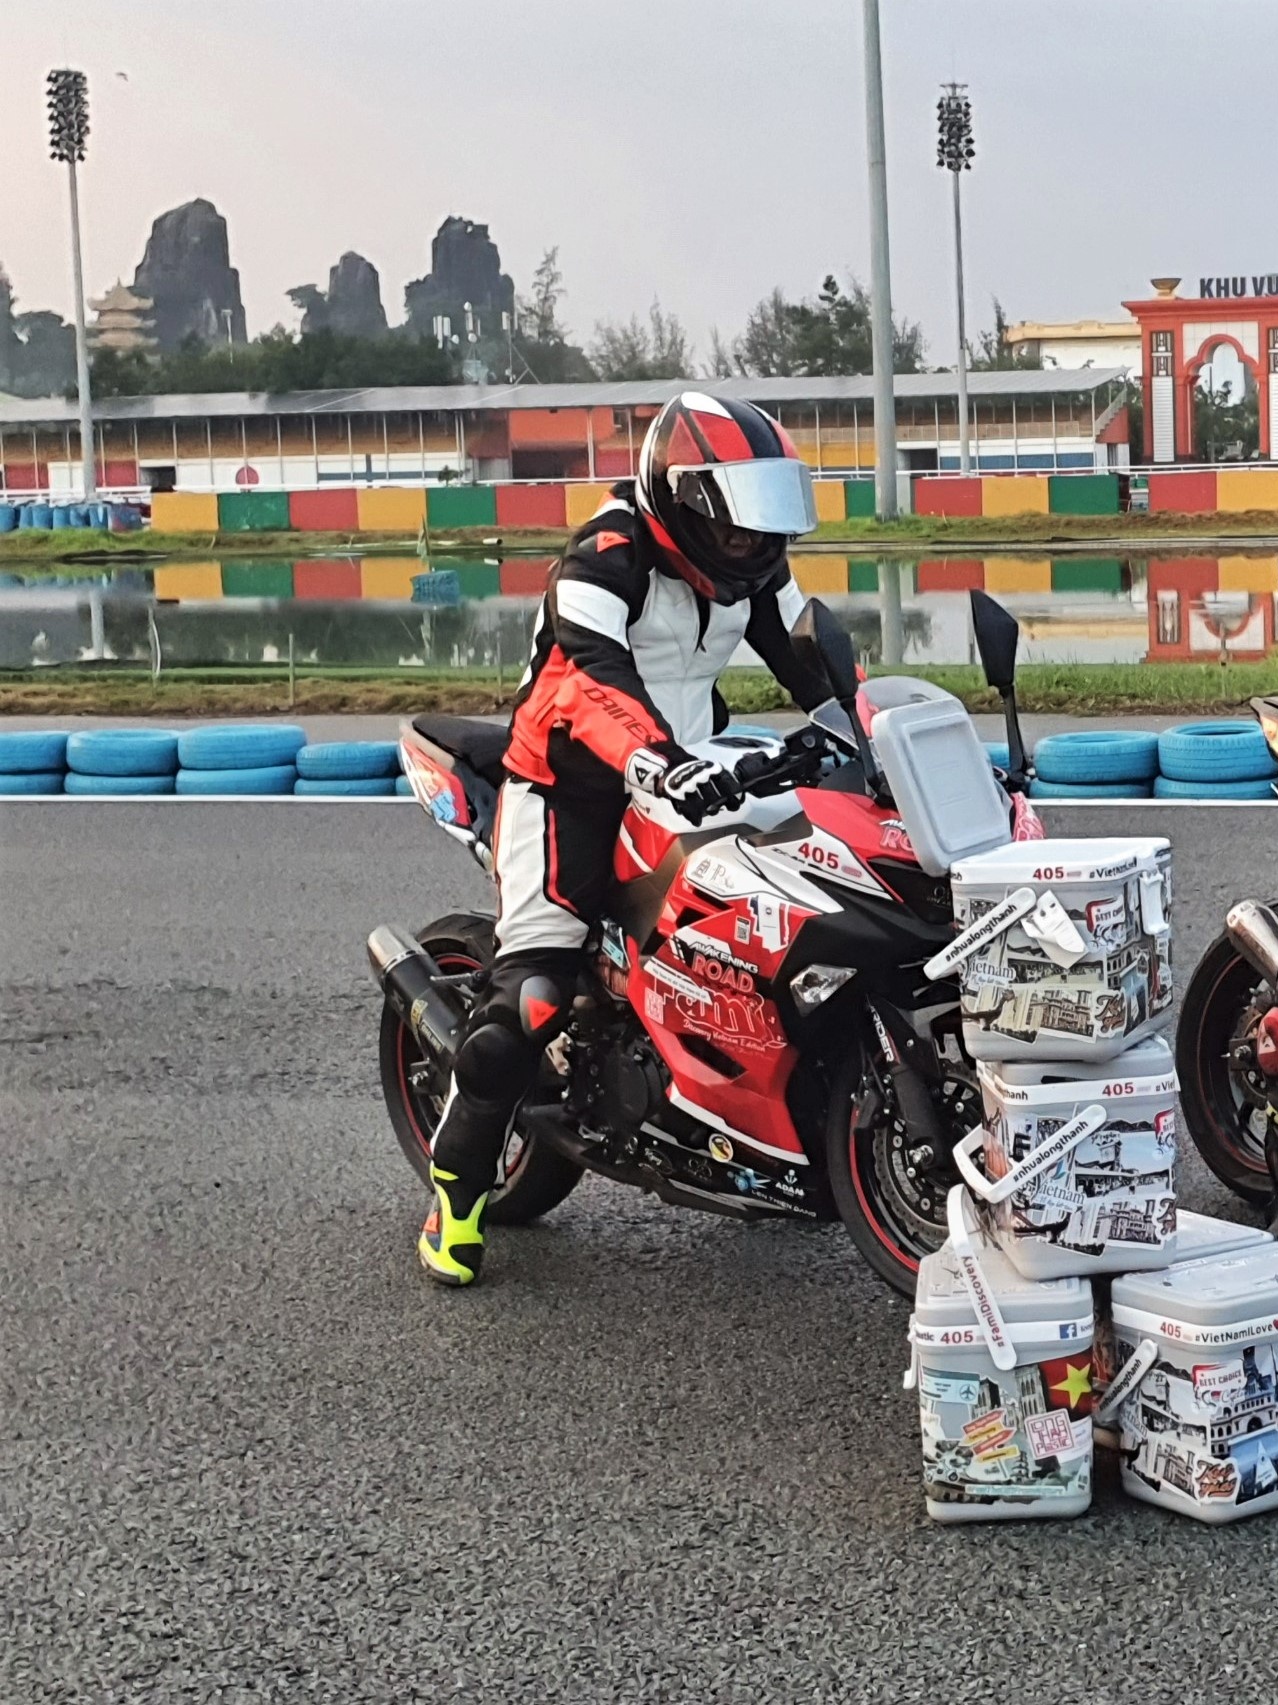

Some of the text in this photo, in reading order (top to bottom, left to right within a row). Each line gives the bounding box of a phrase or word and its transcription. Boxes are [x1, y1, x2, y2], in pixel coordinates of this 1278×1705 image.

[1200, 278, 1246, 298] KHU
[798, 842, 839, 870] 405
[1033, 867, 1064, 880] 405
[945, 904, 1017, 962] #nhualongthanh
[689, 941, 758, 974] AWAKENING
[691, 951, 754, 994] ROAD
[683, 1019, 713, 1041] Discovery
[712, 1031, 739, 1044] Vietnam
[1102, 1082, 1134, 1096] 405
[1013, 1121, 1089, 1182] #nhualongthanh
[775, 1182, 805, 1196] ADAM
[962, 1255, 1006, 1347] #FamiDiscovery
[941, 1330, 973, 1344] 405
[1160, 1321, 1182, 1338] 405
[1200, 1370, 1242, 1386] BEST CHOICE
